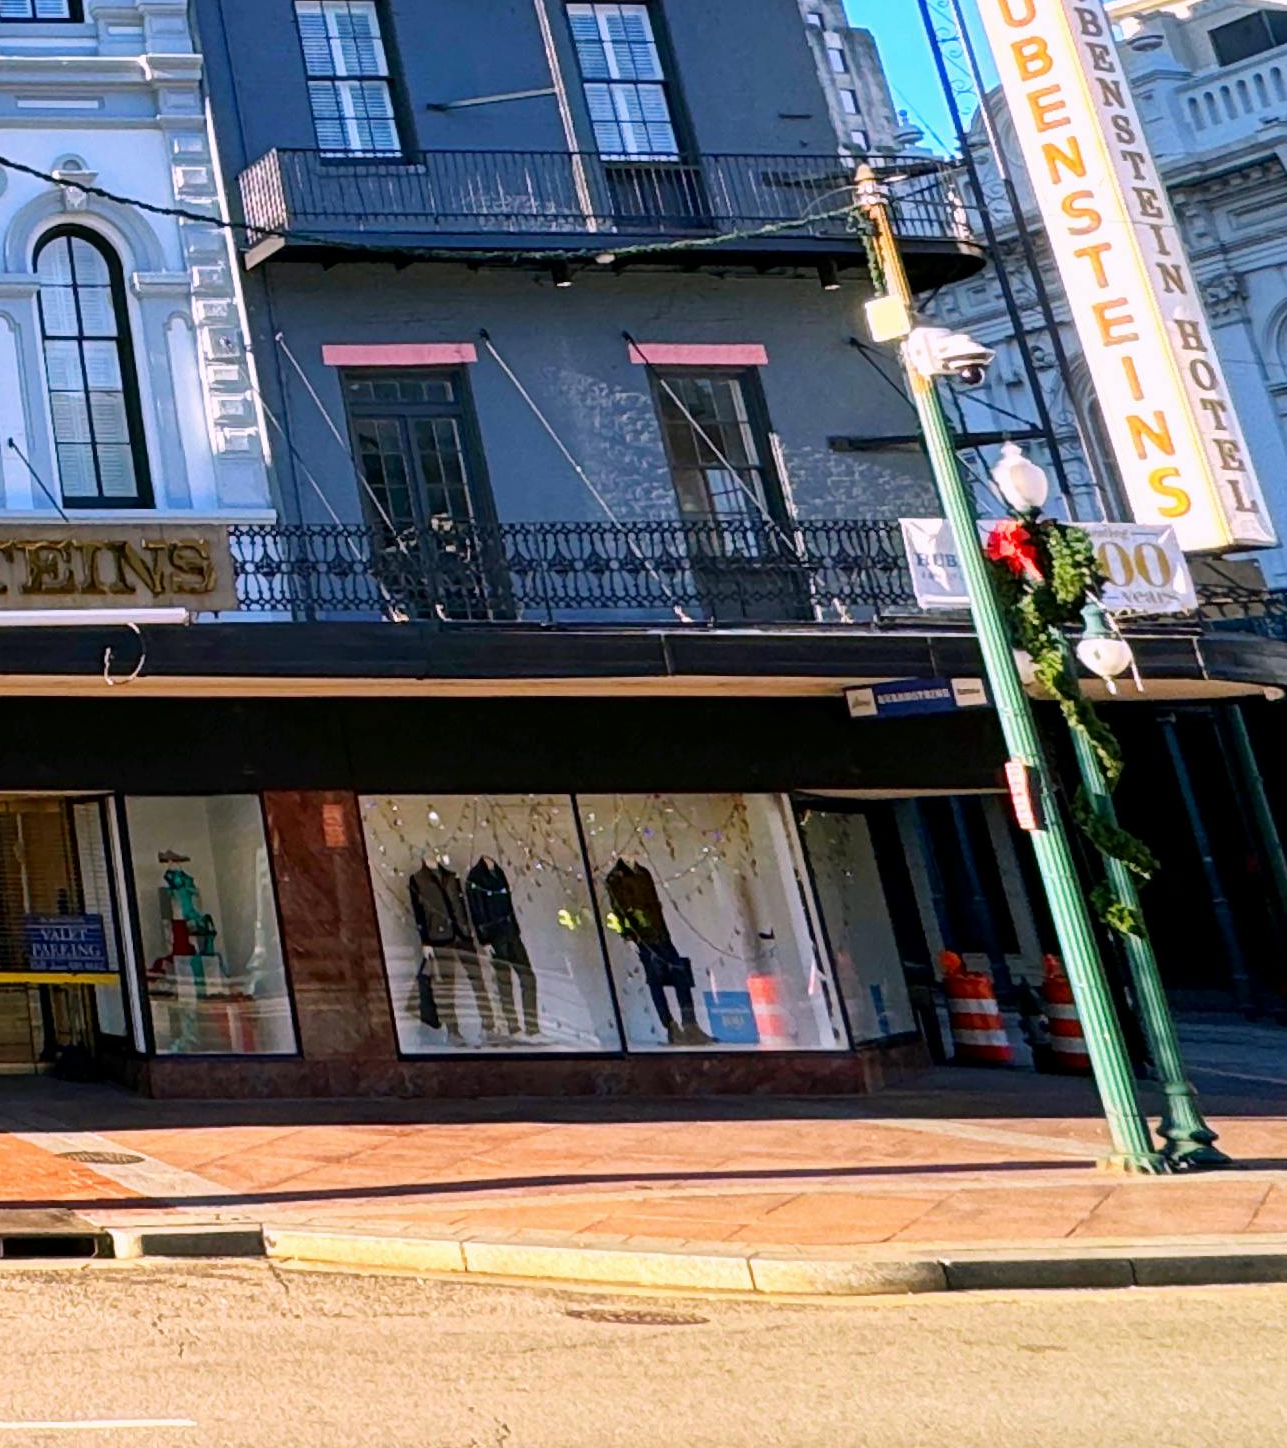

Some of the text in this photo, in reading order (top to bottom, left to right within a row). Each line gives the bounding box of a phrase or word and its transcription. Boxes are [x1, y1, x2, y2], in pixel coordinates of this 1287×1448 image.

[1174, 318, 1259, 514] HOTEL
[1097, 541, 1171, 588] 00
[32, 942, 101, 958] PARKING
[40, 927, 89, 942] VALET
